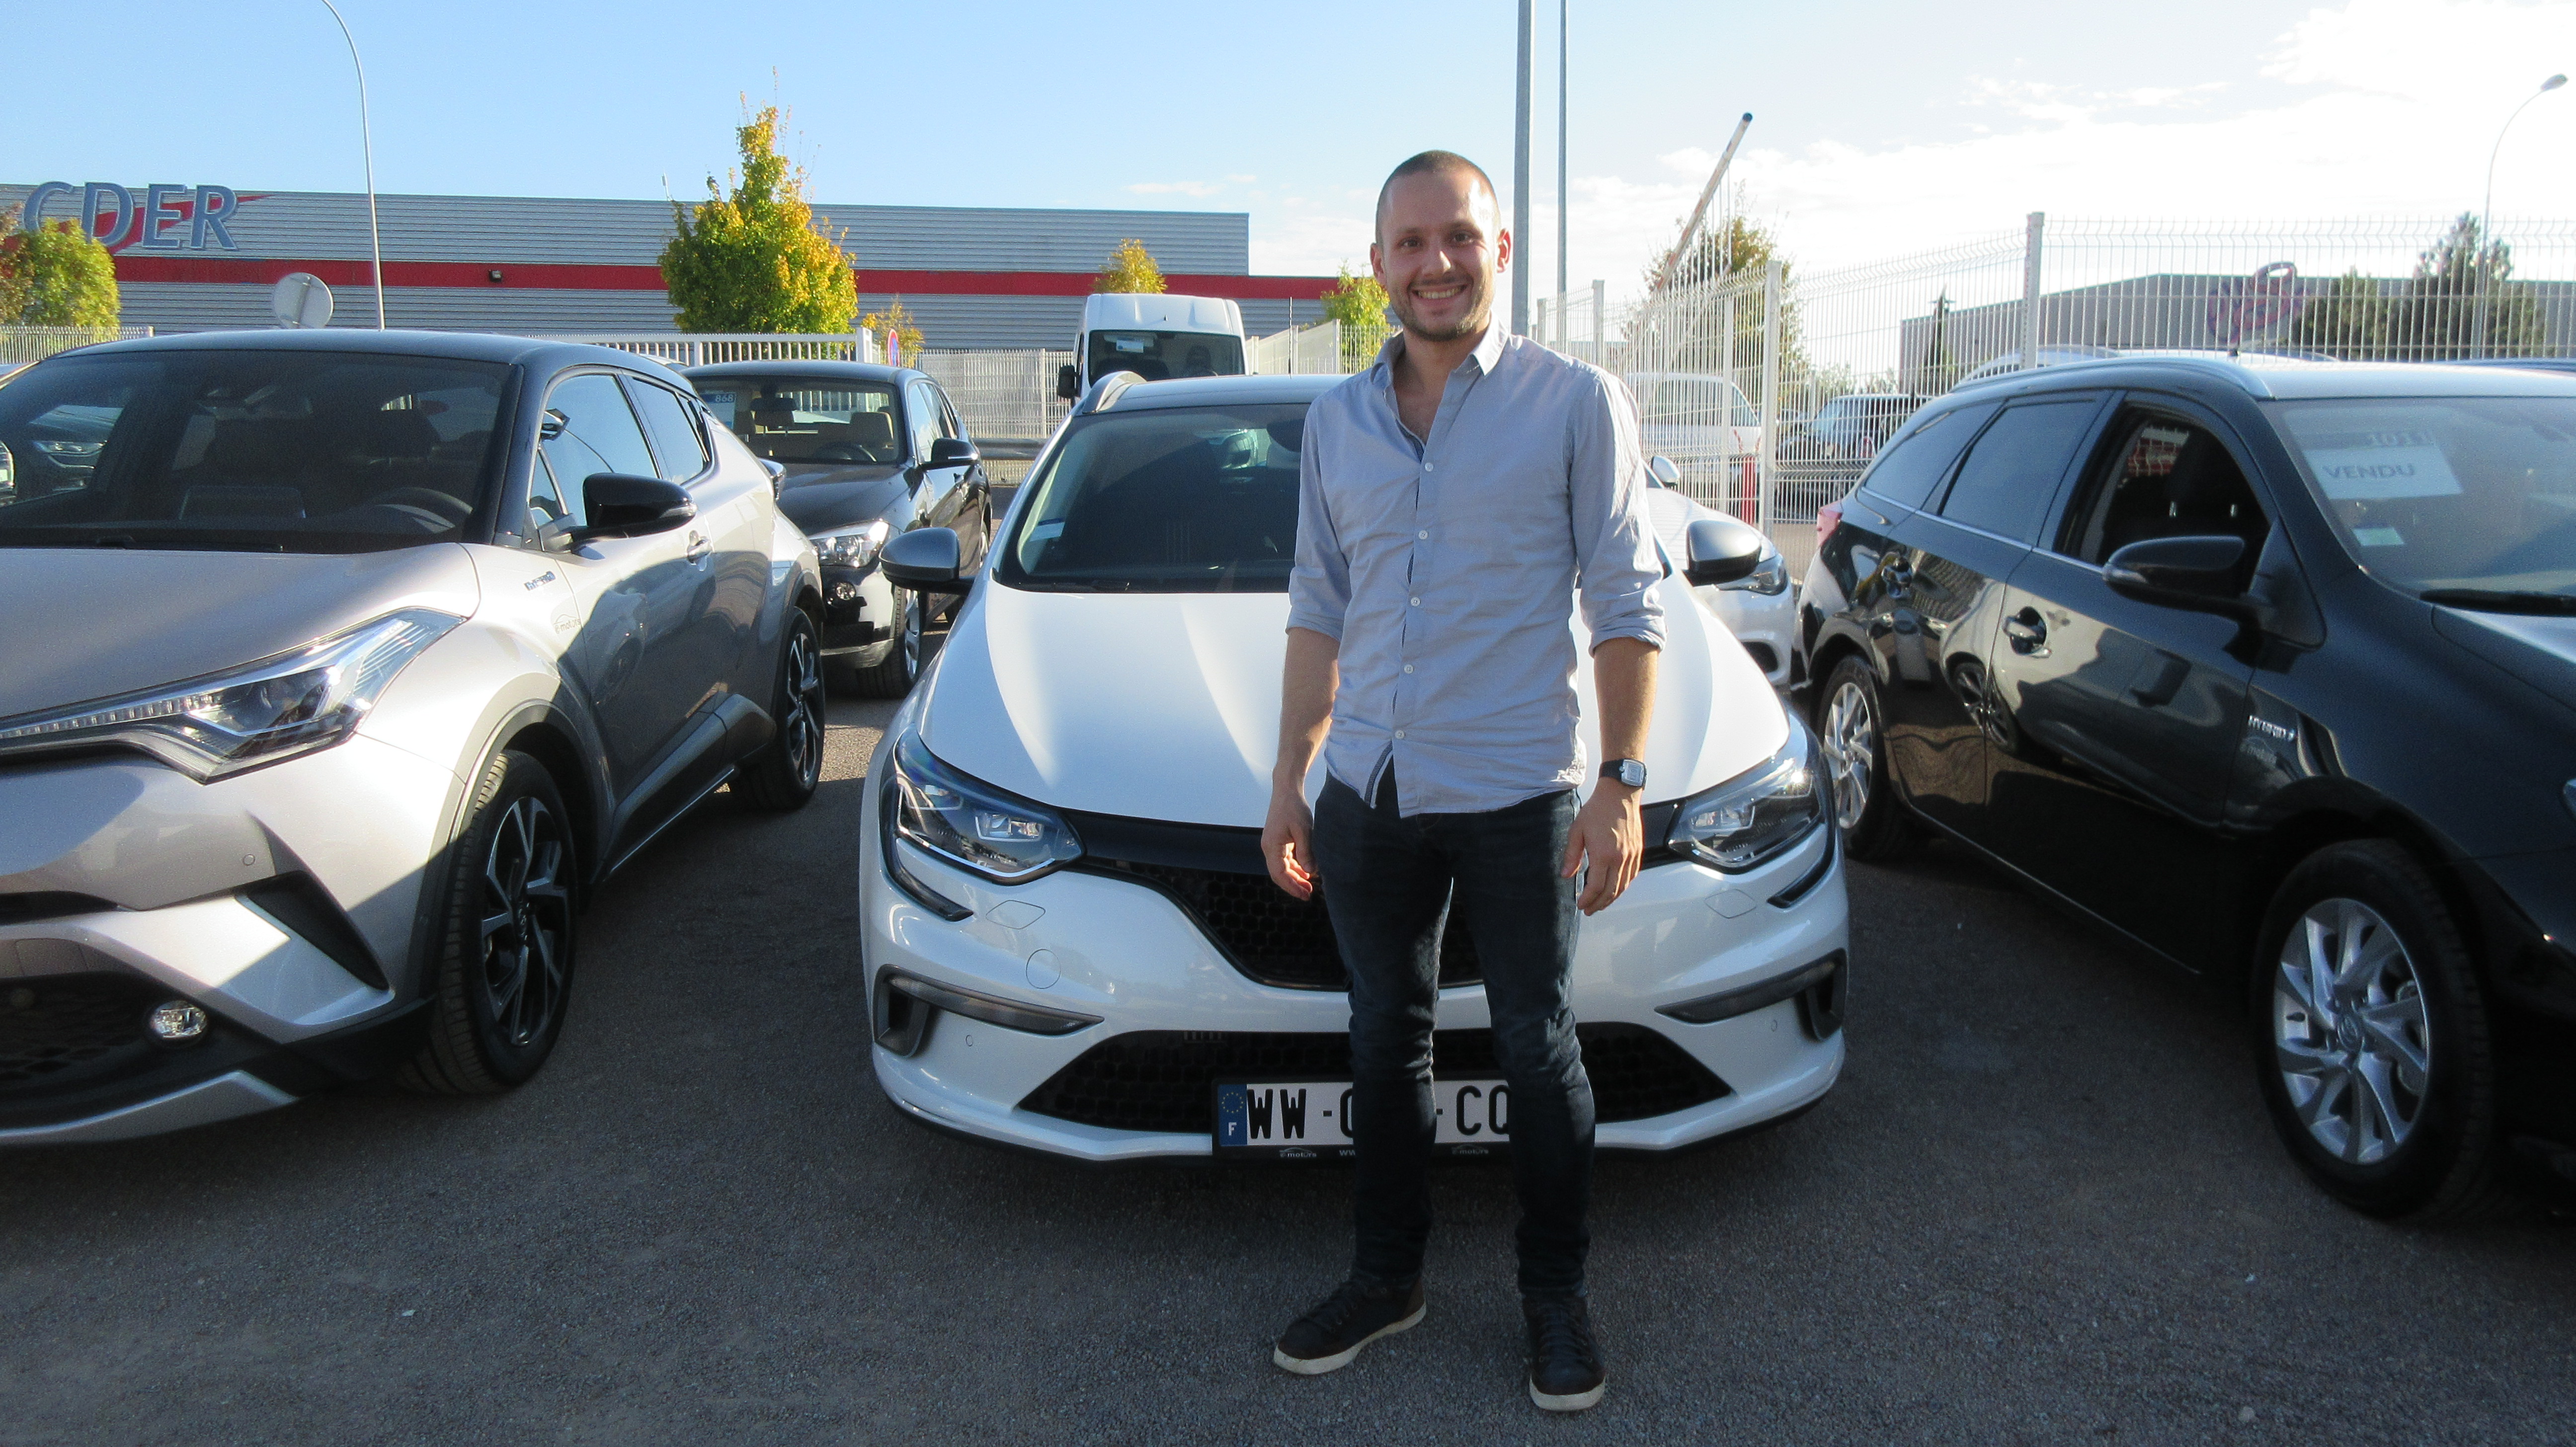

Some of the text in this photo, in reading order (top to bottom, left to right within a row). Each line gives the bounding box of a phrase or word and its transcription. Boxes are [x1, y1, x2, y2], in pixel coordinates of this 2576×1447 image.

[23, 181, 240, 251] CDER
[2323, 463, 2415, 479] VENDU
[1228, 1122, 1237, 1136] F
